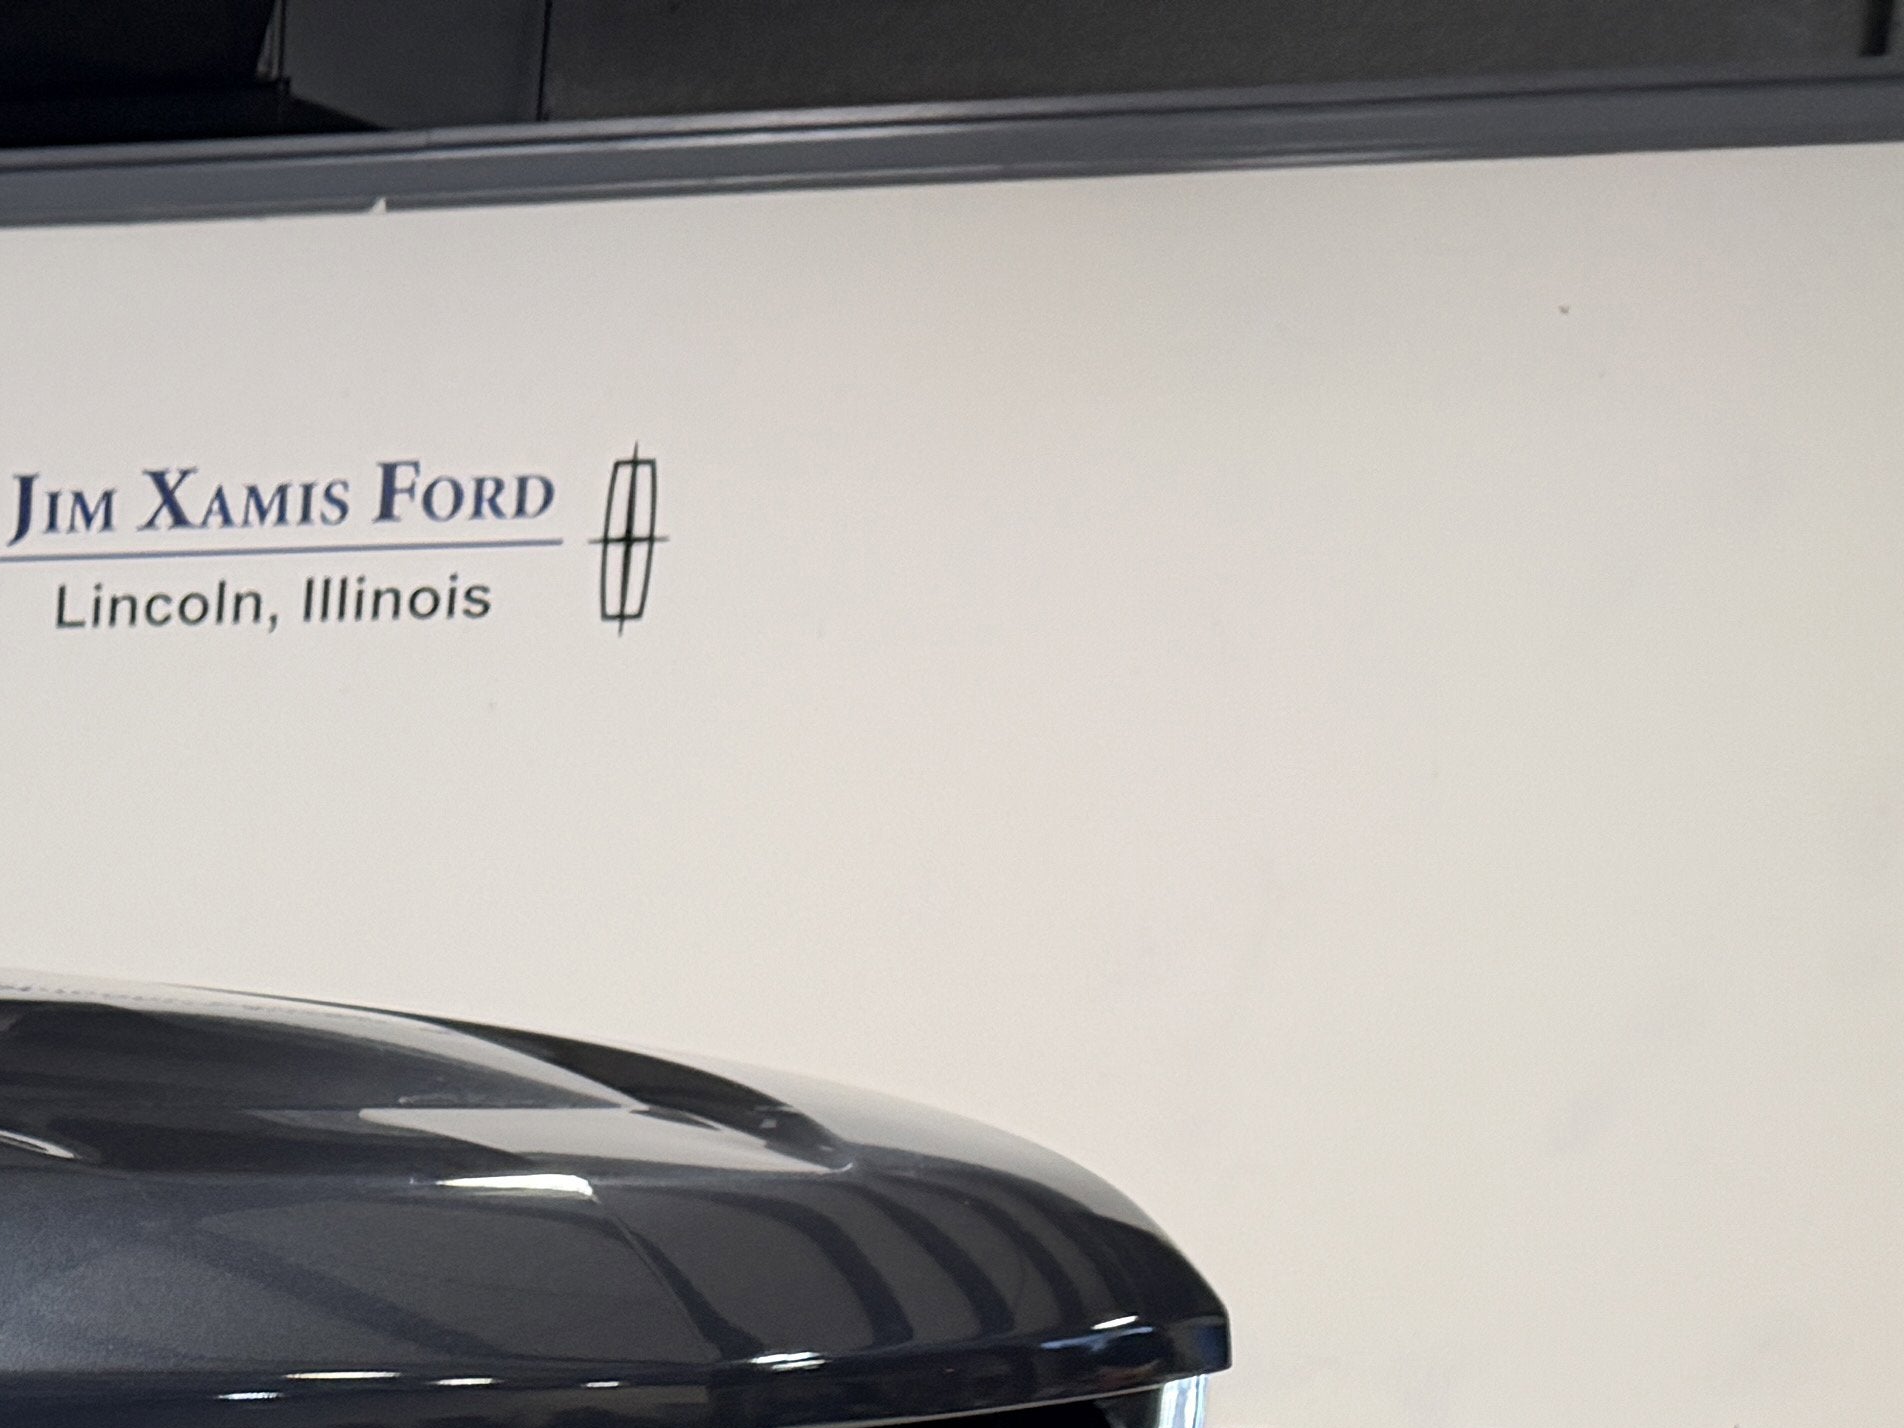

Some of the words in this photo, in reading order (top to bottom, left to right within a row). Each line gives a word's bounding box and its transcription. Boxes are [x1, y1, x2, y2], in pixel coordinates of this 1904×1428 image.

[7, 471, 120, 549] JIM
[136, 467, 351, 532] XAMIS
[373, 459, 557, 524] FORD
[54, 580, 280, 635] Lincoln,
[301, 573, 492, 624] Illinois
